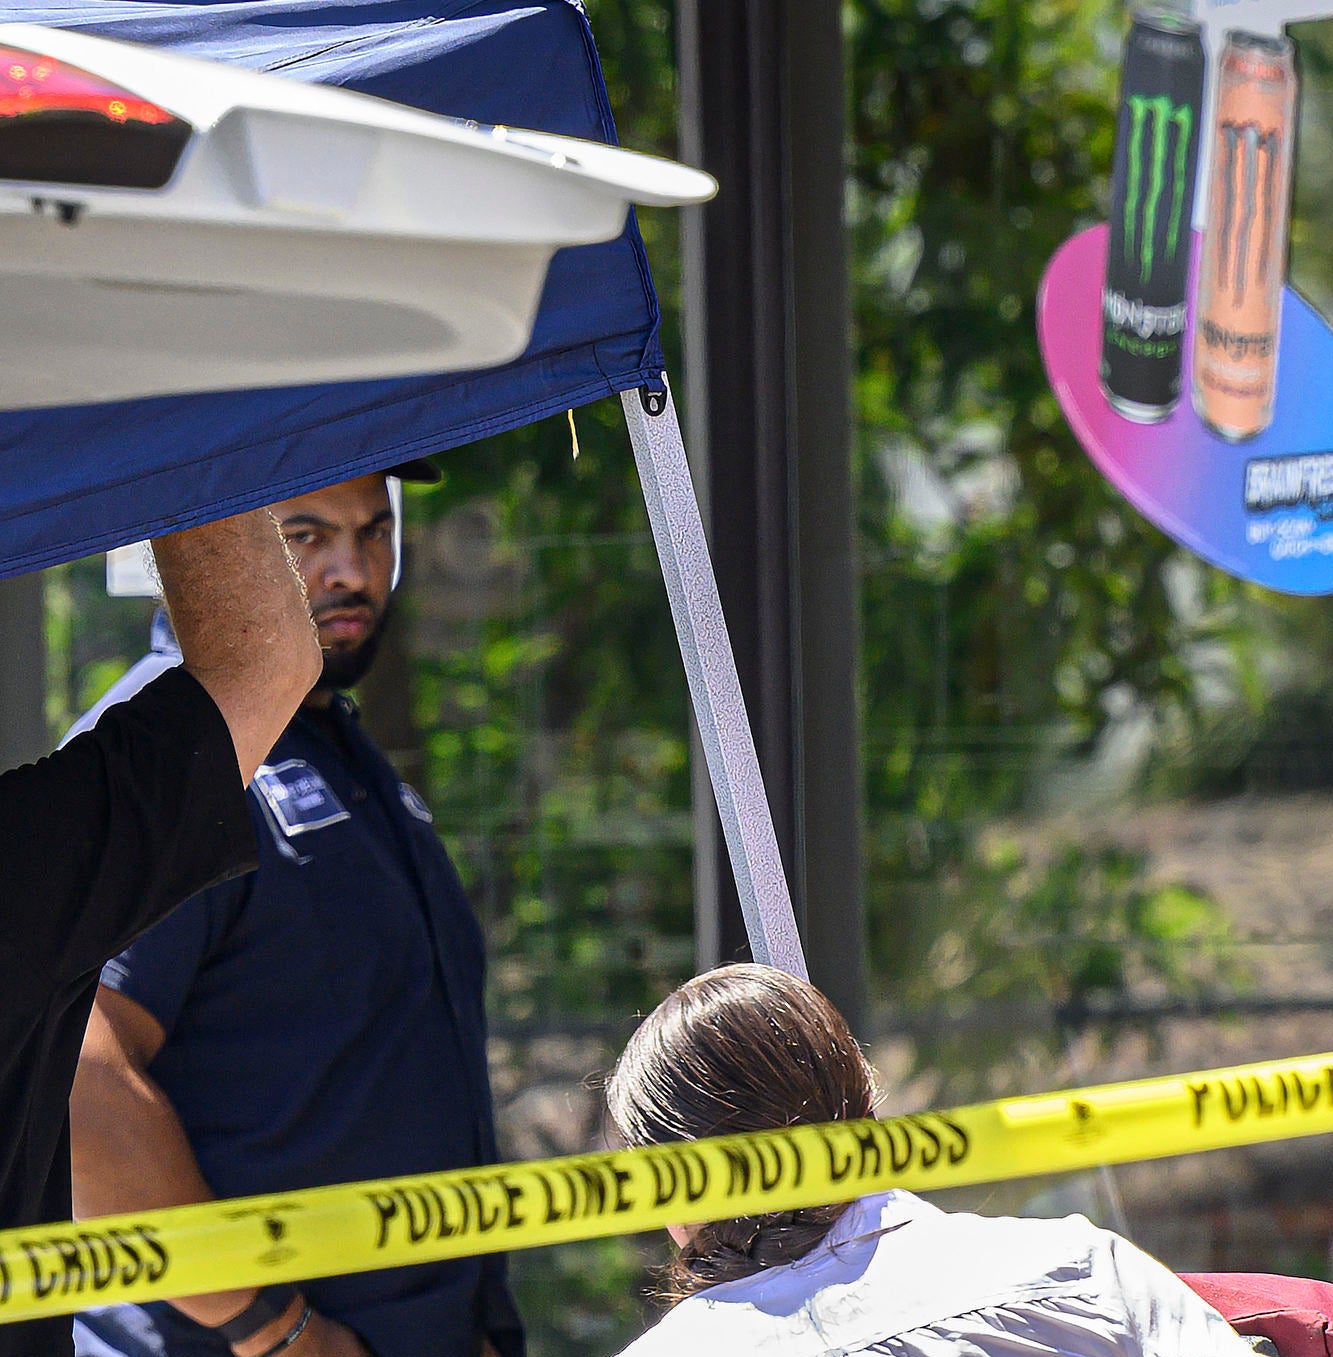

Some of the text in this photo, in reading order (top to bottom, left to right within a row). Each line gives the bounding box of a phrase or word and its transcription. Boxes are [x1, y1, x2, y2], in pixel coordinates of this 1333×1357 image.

[367, 1112, 969, 1249] POLICE LINE DO NOT CROSS
[17, 1223, 169, 1299] CROSS
